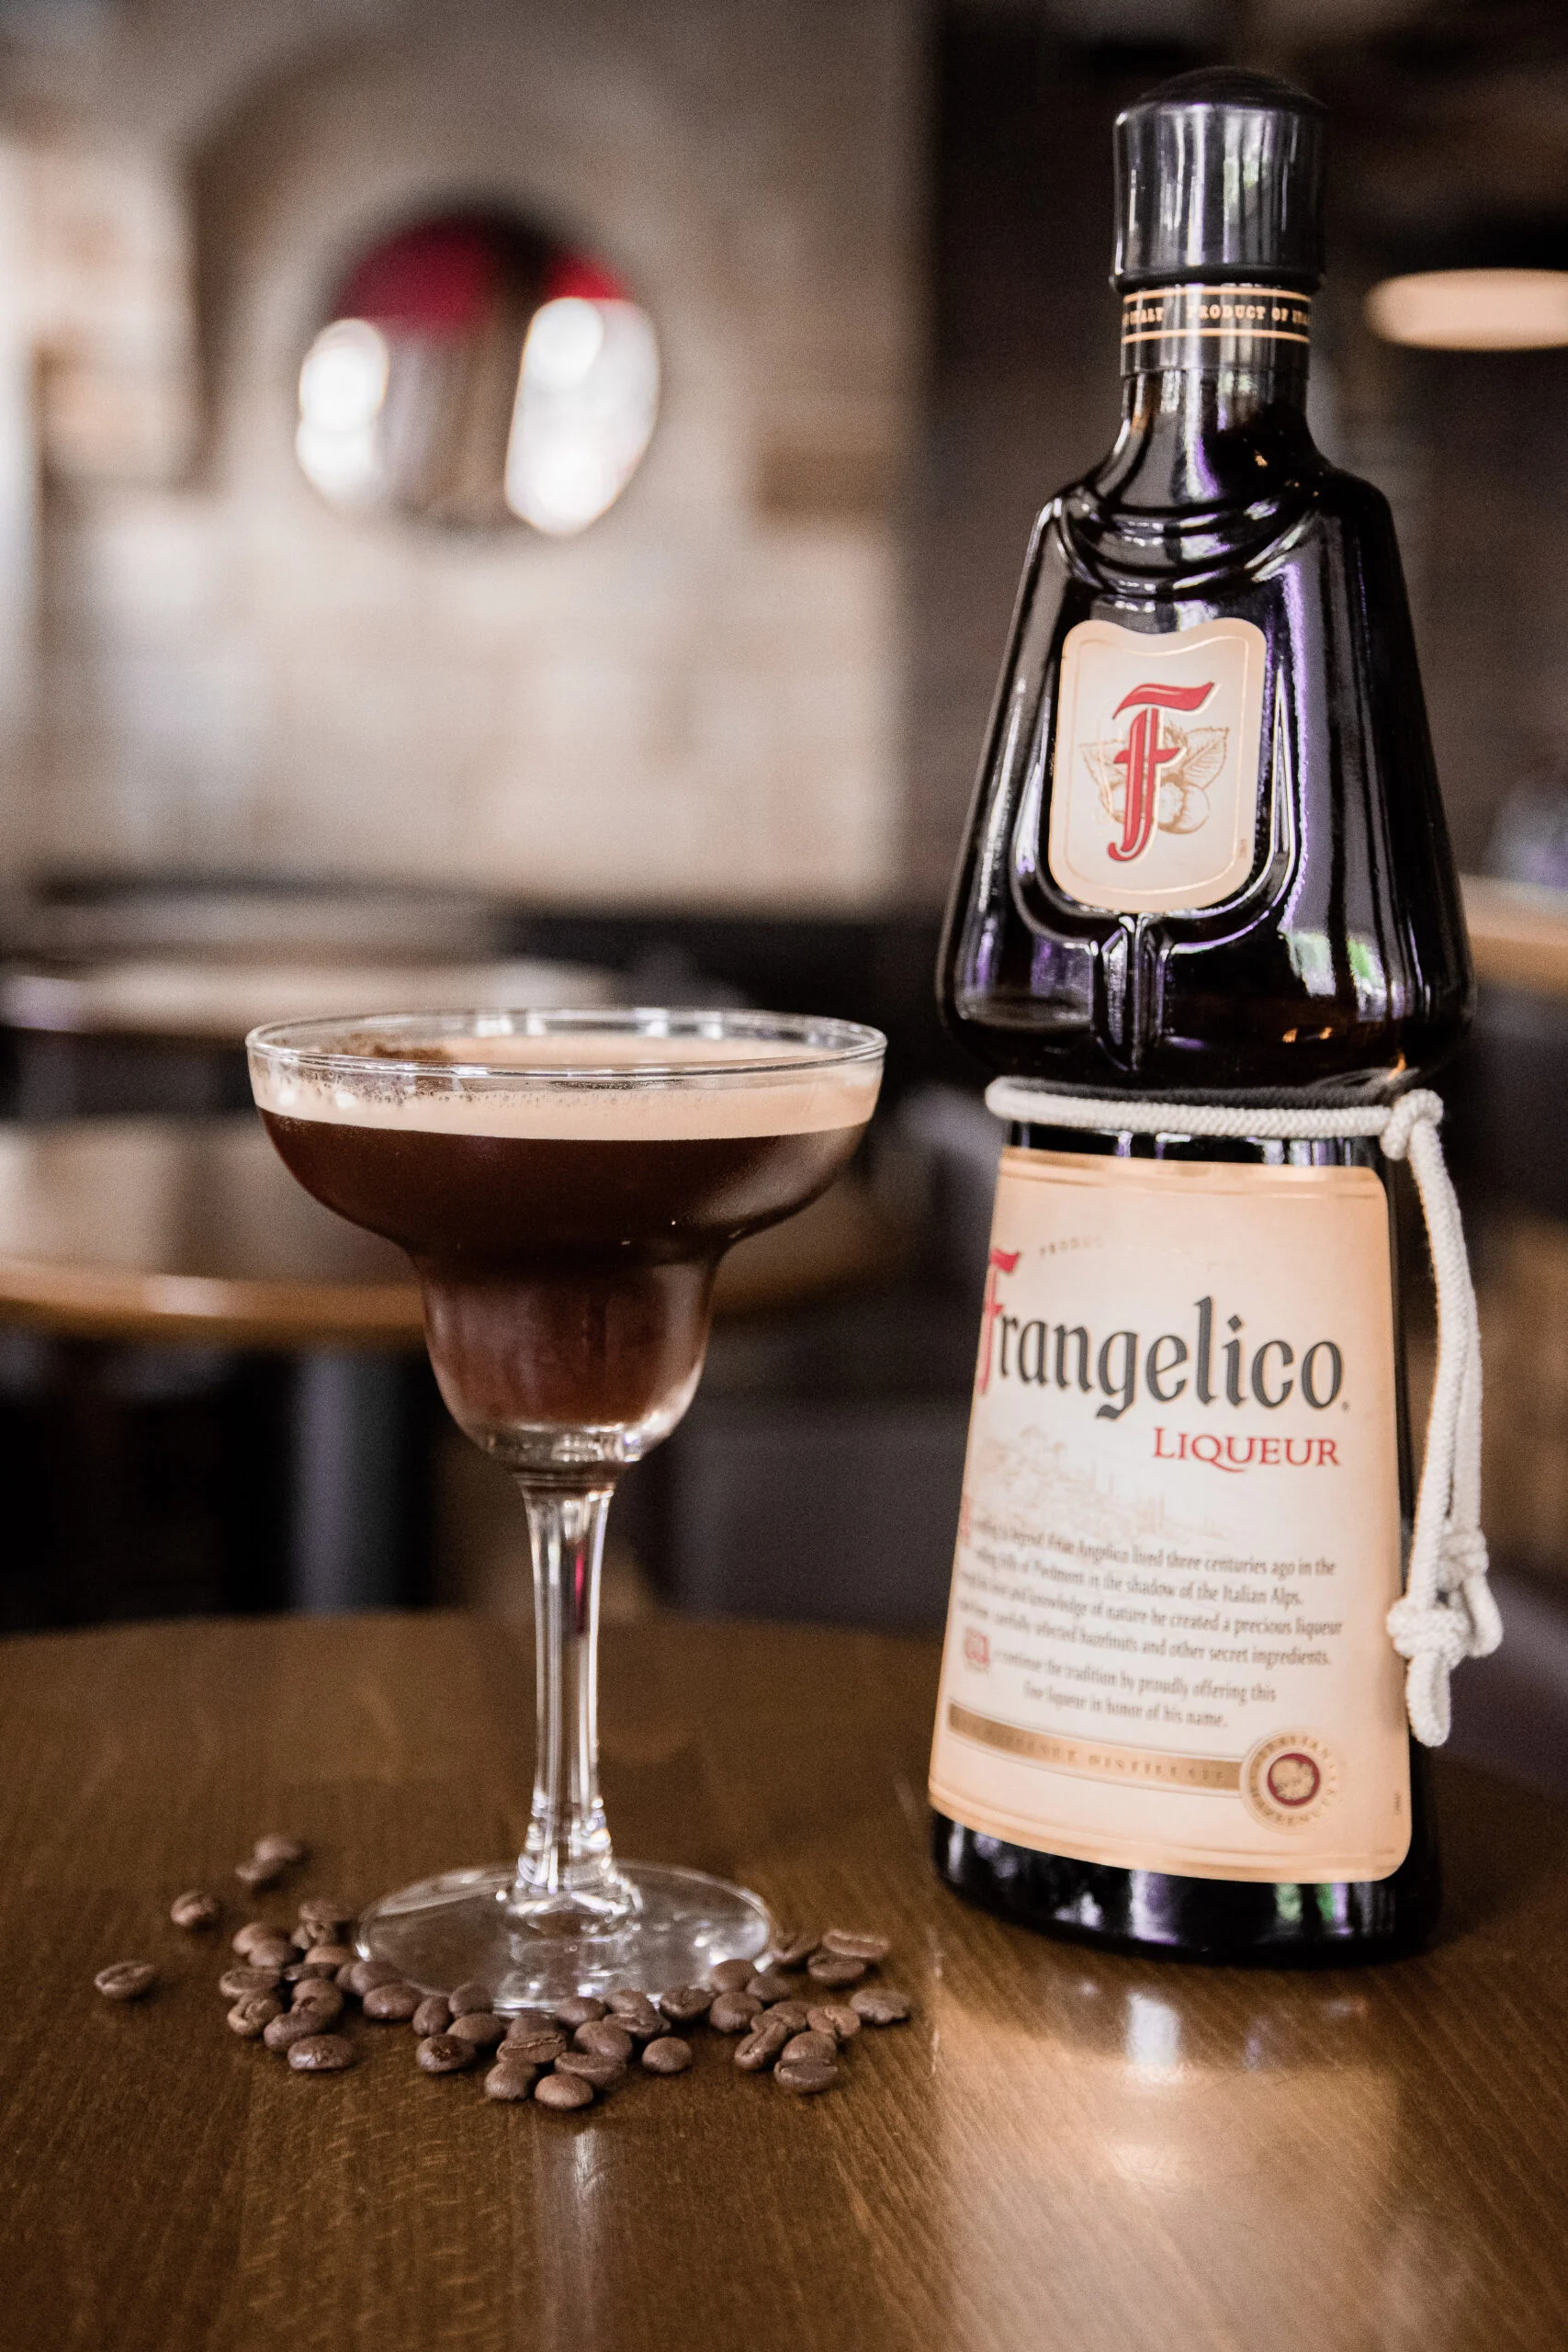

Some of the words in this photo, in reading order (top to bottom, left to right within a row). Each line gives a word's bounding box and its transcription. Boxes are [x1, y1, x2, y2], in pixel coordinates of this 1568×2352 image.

[1107, 682, 1220, 862] F
[1270, 1562, 1295, 1581] ago
[1299, 1556, 1312, 1576] in
[1315, 1556, 1336, 1577] the
[1197, 1580, 1220, 1601] the
[1168, 1611, 1220, 1633] created
[1234, 1617, 1292, 1639] precious
[1294, 1614, 1344, 1641] liqueur
